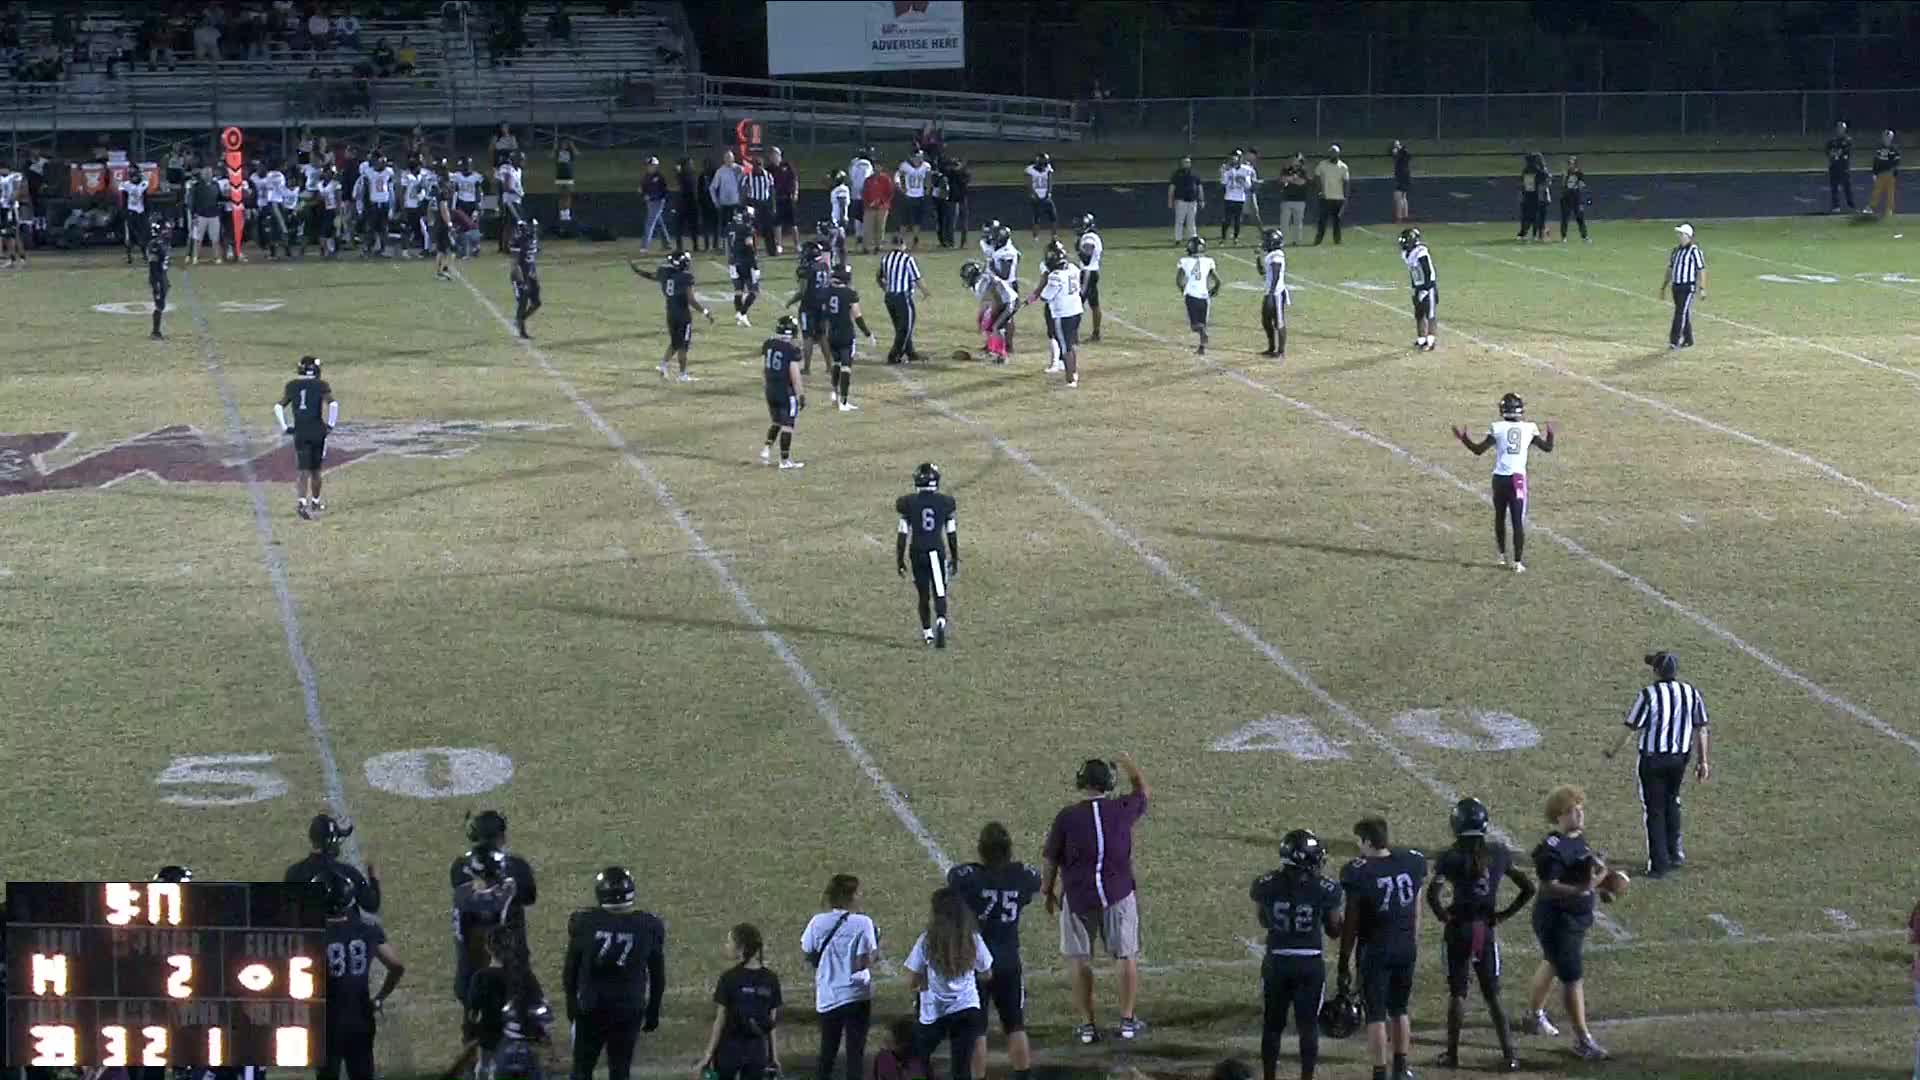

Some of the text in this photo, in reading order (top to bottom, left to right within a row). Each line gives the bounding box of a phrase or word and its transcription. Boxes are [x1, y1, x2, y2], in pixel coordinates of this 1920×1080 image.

[872, 37, 960, 50] ADVERTISE HERE
[665, 279, 675, 296] 8
[829, 295, 839, 313] 9
[766, 349, 784, 370] 16
[299, 389, 307, 409] 1
[1507, 427, 1522, 455] 9
[922, 507, 935, 531] 6
[155, 746, 514, 806] 50
[978, 889, 1019, 922] 75
[1377, 872, 1414, 912] 70
[1273, 901, 1313, 932] 52
[327, 939, 368, 976] 88
[595, 930, 635, 966] 77
